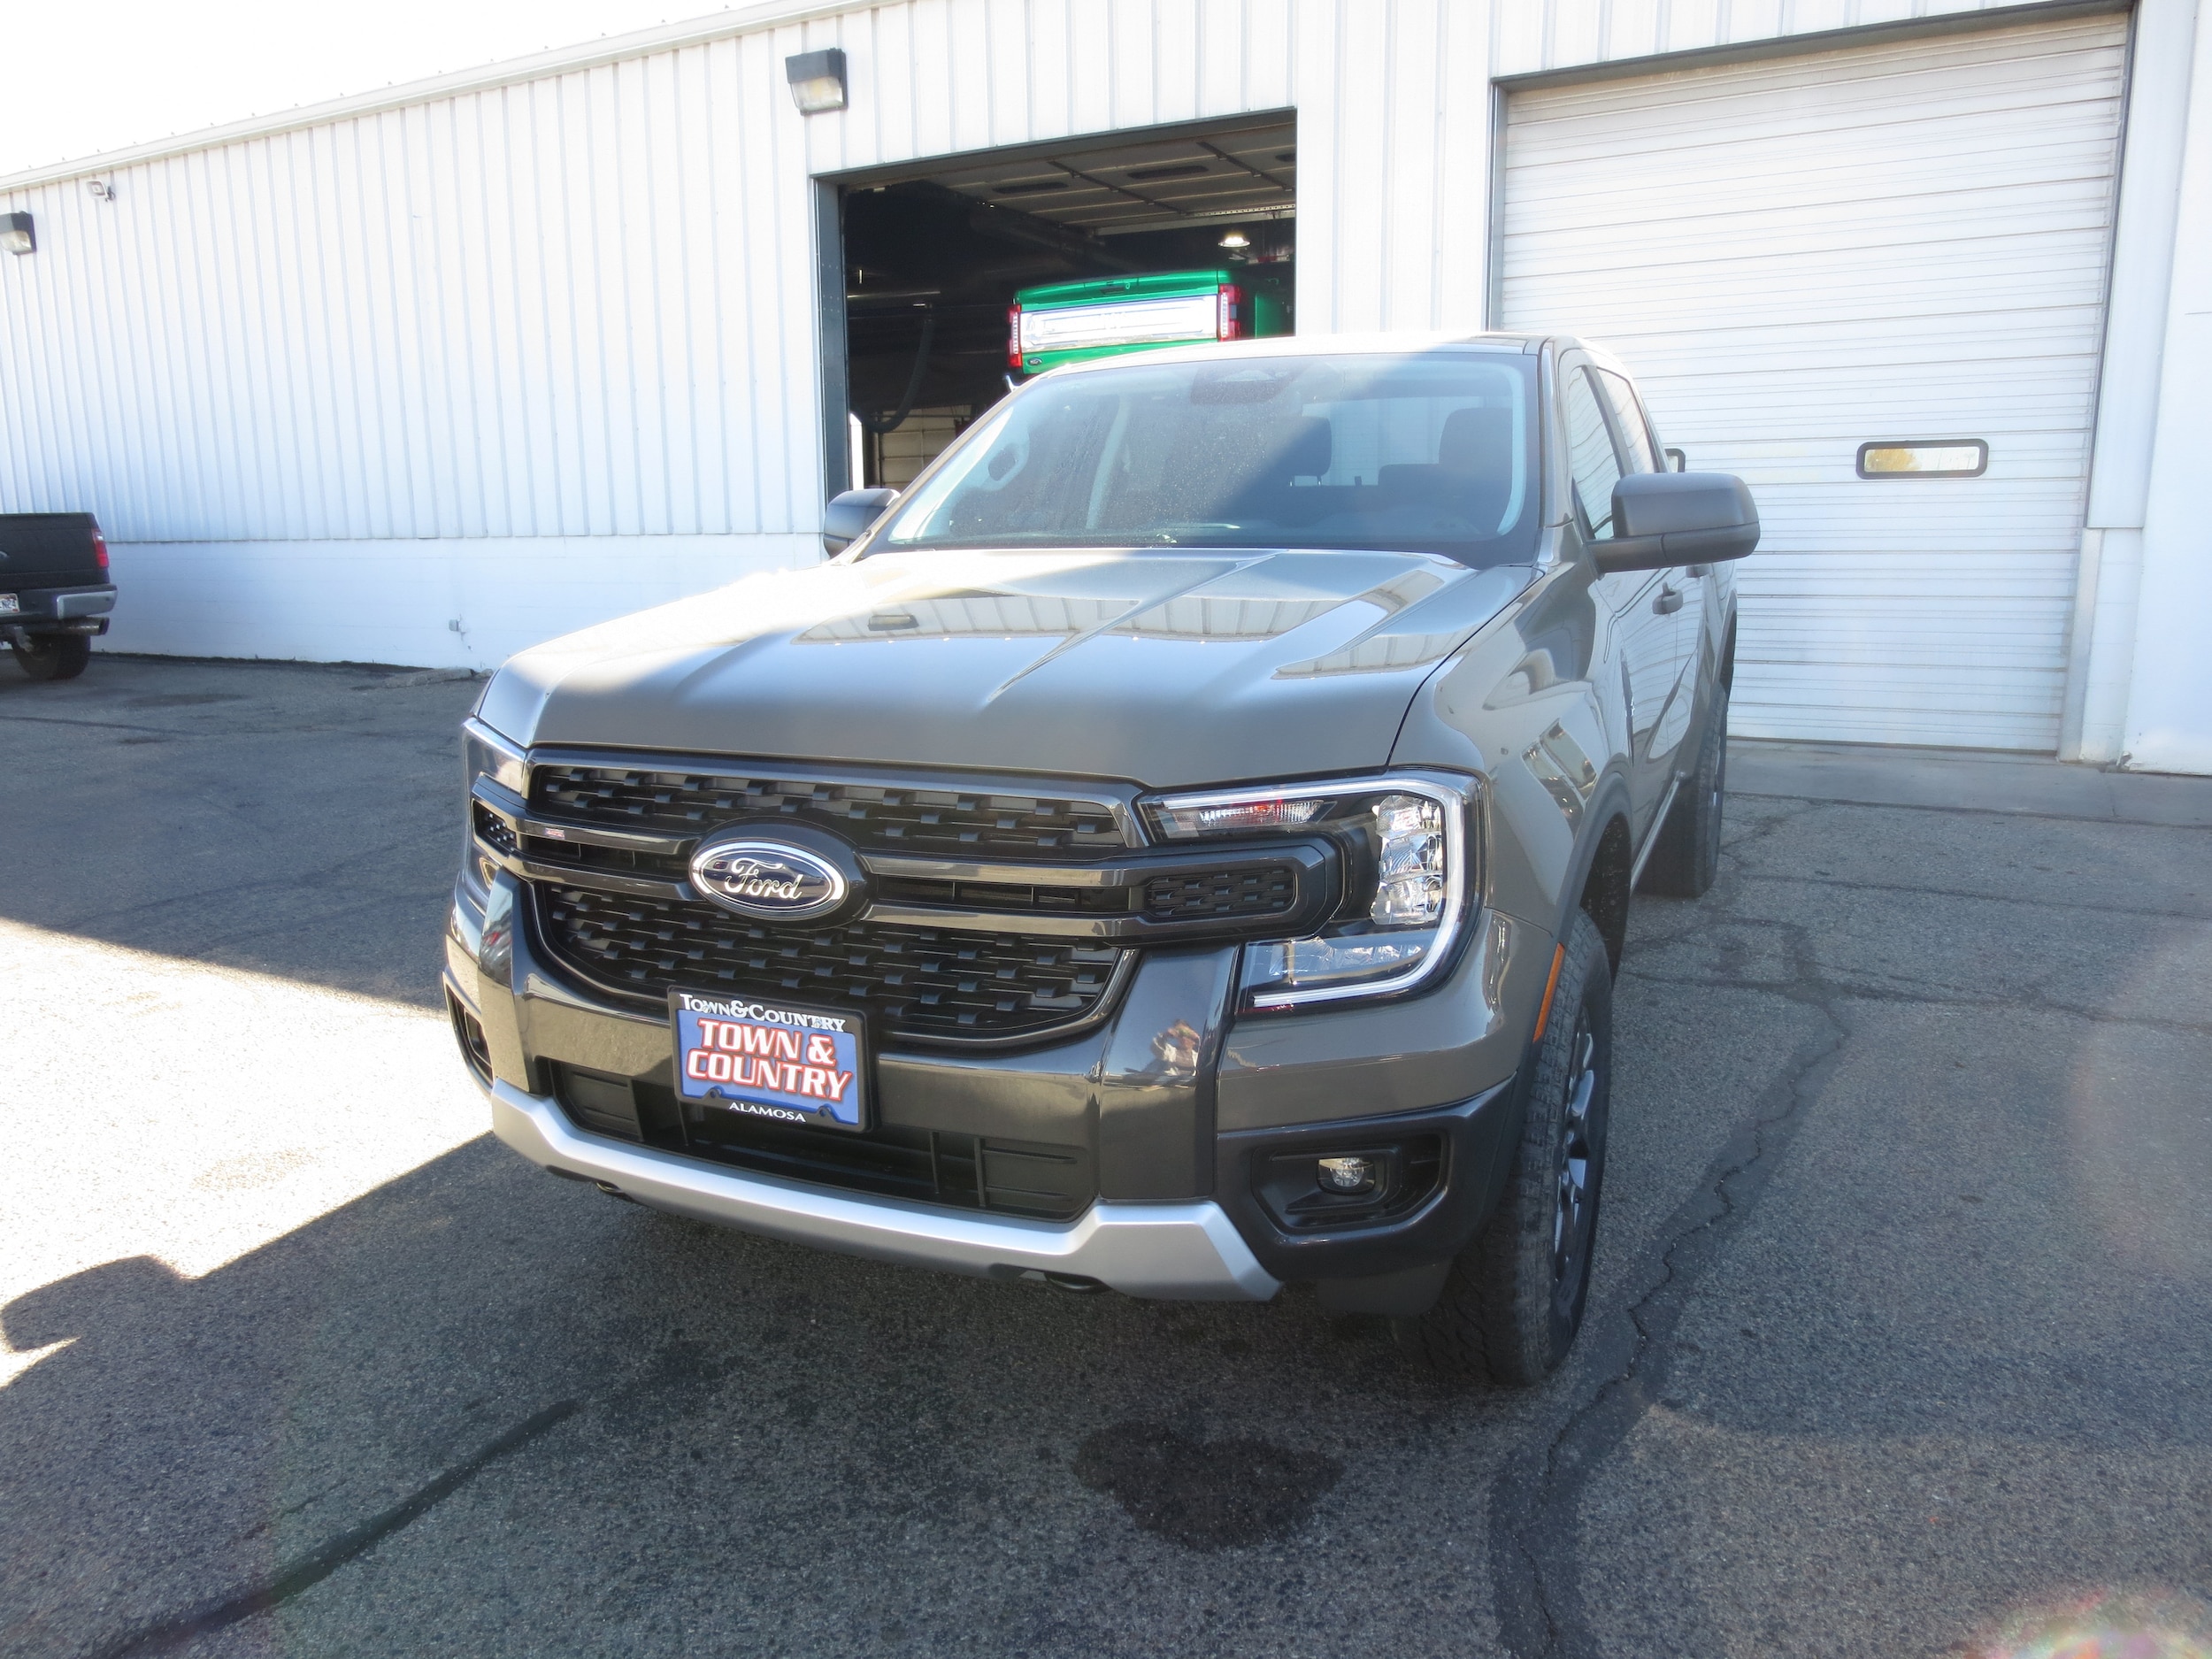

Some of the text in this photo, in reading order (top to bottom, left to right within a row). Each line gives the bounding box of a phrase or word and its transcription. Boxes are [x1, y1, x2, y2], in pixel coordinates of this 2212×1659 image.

[724, 857, 803, 900] Ford
[697, 1018, 836, 1066] TOWN &
[687, 1048, 853, 1101] COUNTRY
[729, 1102, 806, 1123] ALAMOSA
